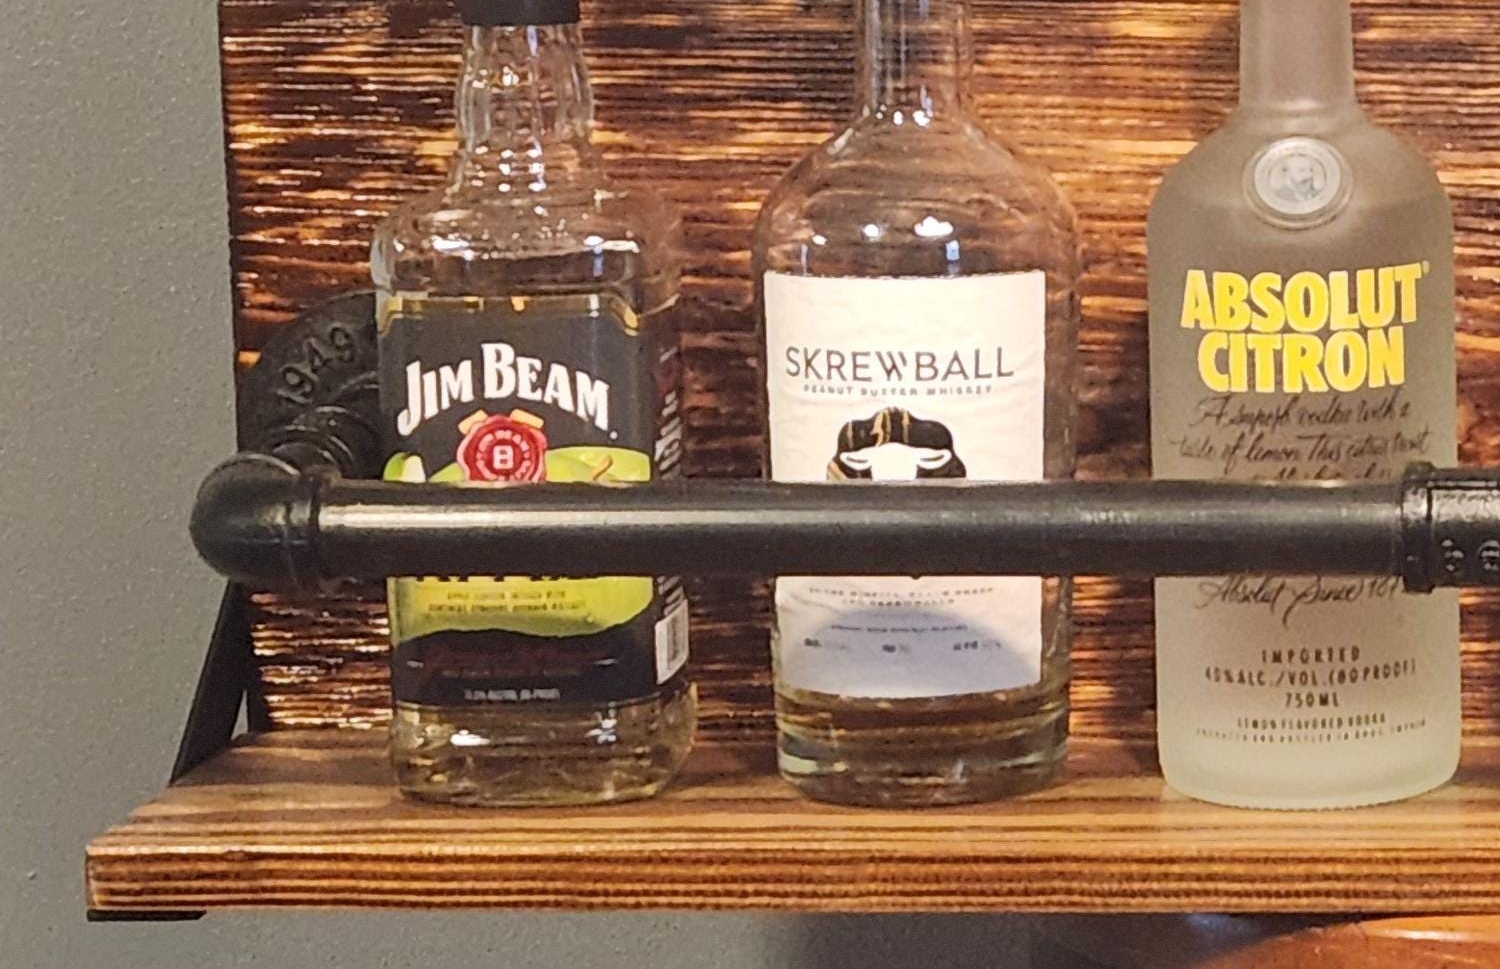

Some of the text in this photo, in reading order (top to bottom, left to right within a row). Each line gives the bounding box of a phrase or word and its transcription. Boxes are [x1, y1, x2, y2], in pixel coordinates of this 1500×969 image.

[1181, 262, 1422, 332] ABSOLUT
[398, 360, 475, 436] JIM
[481, 343, 609, 431] BEAM
[786, 346, 1014, 382] SKREWBALL
[1198, 326, 1405, 394] CITRON
[1262, 645, 1360, 664] IMPORTED
